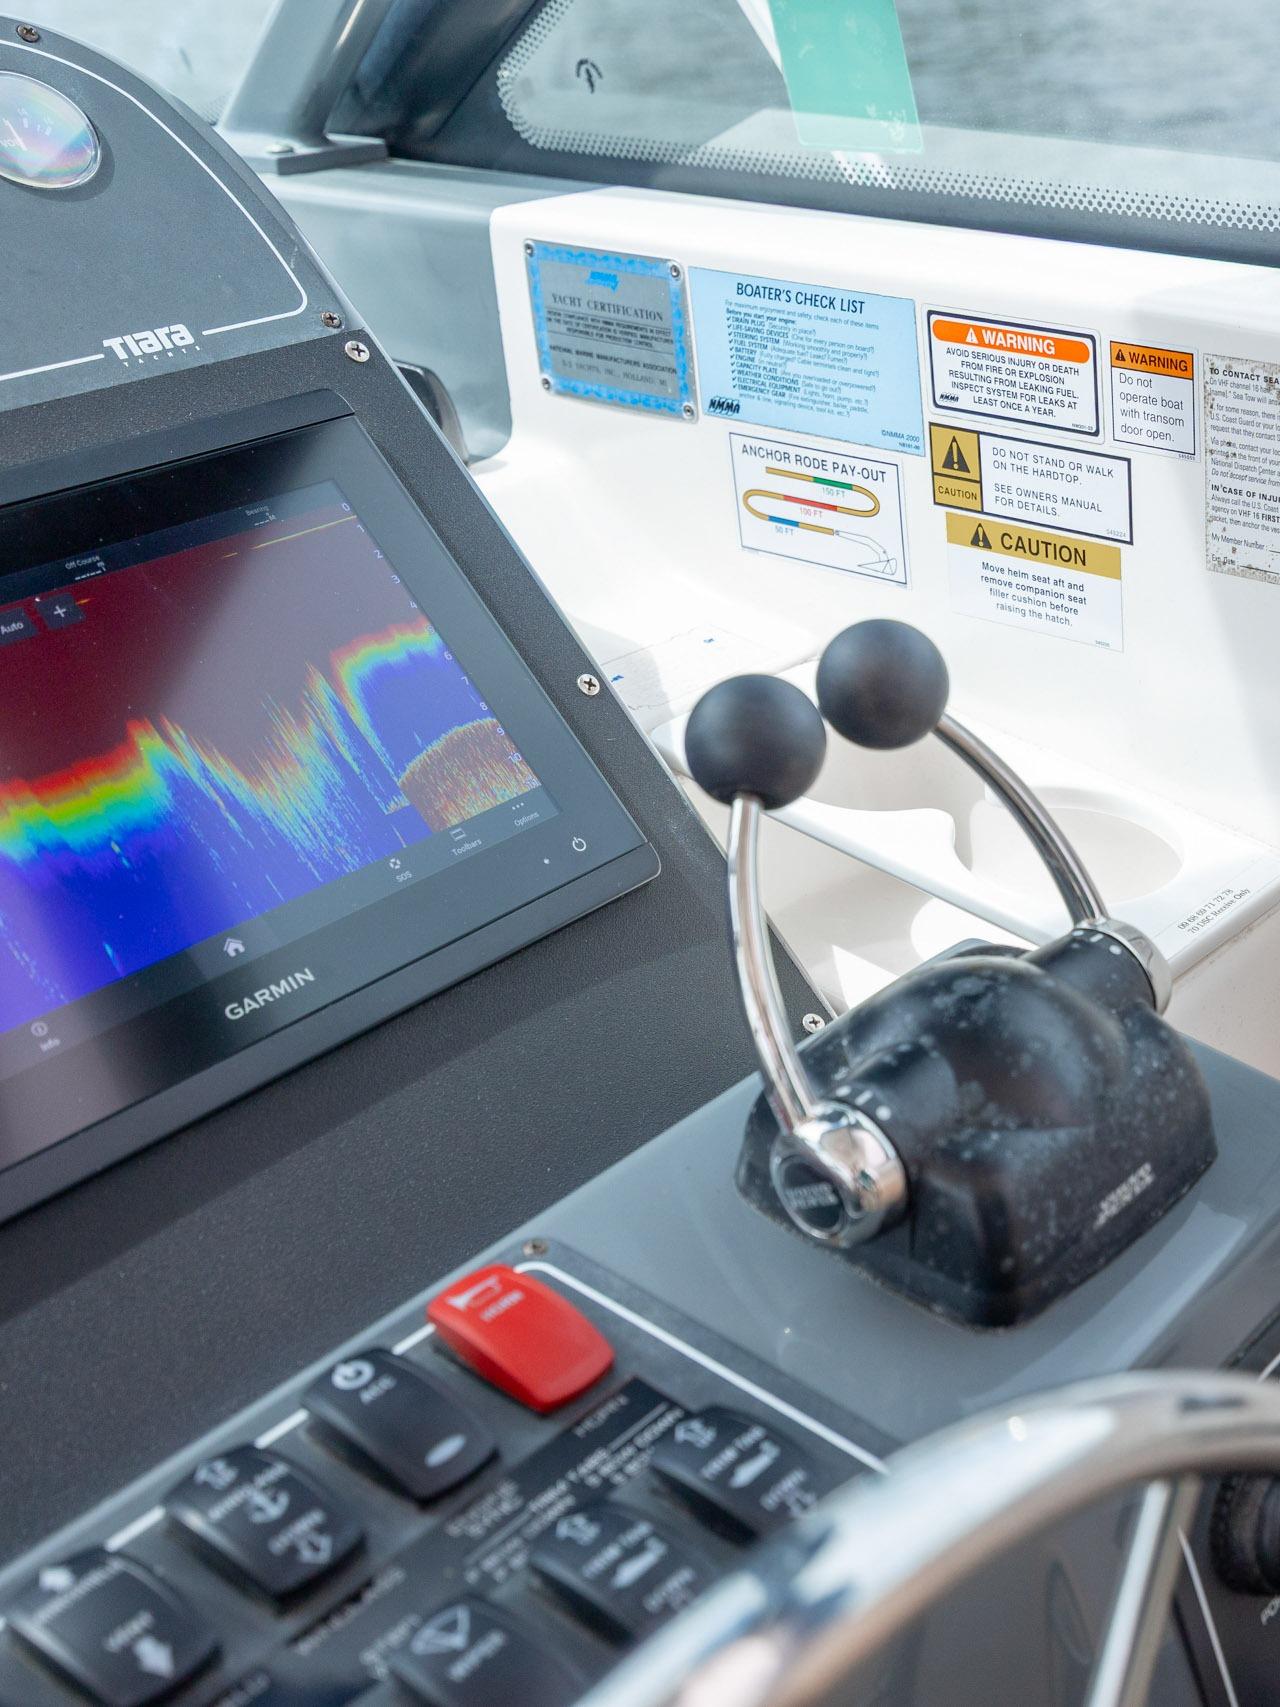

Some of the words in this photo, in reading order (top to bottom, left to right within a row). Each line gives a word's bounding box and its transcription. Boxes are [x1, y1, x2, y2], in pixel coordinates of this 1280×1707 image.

[551, 293, 582, 308] YACHT
[586, 299, 664, 322] CERTIFICATION
[736, 282, 792, 304] BOATER'S
[795, 291, 837, 311] CHECK
[840, 297, 866, 315] LIST
[103, 323, 195, 360] Tiara
[981, 329, 1056, 355] WARNING
[946, 347, 970, 358] AVOID
[971, 350, 1007, 365] SERIOUS
[1007, 357, 1037, 369] INJURY
[1037, 361, 1051, 372] OR
[1052, 364, 1080, 377] DEATH
[960, 360, 984, 372] FROM
[985, 364, 1003, 375] FIRE
[1004, 367, 1017, 378] OR
[1018, 369, 1065, 385] EXPLOSION
[1128, 351, 1188, 373] WARNING
[948, 369, 992, 384] RESULTING
[993, 376, 1017, 389] FROM
[1018, 381, 1054, 395] LEAKING
[1056, 387, 1080, 399] FUEL.
[1119, 372, 1134, 386] Do
[1136, 377, 1153, 389] not
[1208, 366, 1220, 376] TO
[1222, 369, 1261, 382] CONTACT
[1263, 375, 1280, 385] SEA
[951, 381, 984, 394] INSPECT
[985, 386, 1018, 400] SYSTEM
[1019, 392, 1037, 403] FOR
[1038, 395, 1066, 408] LEAKS
[1067, 400, 1078, 410] AT
[972, 395, 999, 408] LEAST
[999, 399, 1023, 412] ONCE
[1024, 404, 1031, 413] A
[1031, 405, 1056, 418] YEAR.
[1119, 391, 1158, 407] operate
[1160, 395, 1184, 411] boat
[1120, 408, 1140, 419] with
[1142, 410, 1185, 428] transom
[1120, 423, 1144, 436] door
[1145, 429, 1175, 443] open.
[741, 443, 791, 464] ANCHOR
[794, 453, 829, 472] RODE
[832, 461, 887, 483] PAY-OUT
[992, 446, 1007, 458] DO
[1009, 450, 1030, 462] NOT
[1032, 454, 1066, 469] STAND
[1068, 461, 1083, 472] OR
[1085, 464, 1114, 479] WALK
[992, 459, 1007, 471] ON
[1009, 462, 1029, 475] THE
[1032, 467, 1082, 486] HARDTOP.
[822, 486, 835, 497] 150
[835, 489, 846, 498] FT
[937, 485, 978, 501] CAUTION
[994, 482, 1013, 495] SEE
[1015, 487, 1058, 504] OWNERS
[1061, 496, 1103, 513] MANUAL
[1211, 483, 1220, 492] IN
[1220, 484, 1244, 497] CASE
[1245, 490, 1257, 499] OF
[799, 506, 812, 517] 100
[812, 509, 823, 519] FT
[994, 495, 1014, 508] FOR
[1017, 500, 1061, 517] DETAILS.
[774, 524, 784, 535] 50
[784, 527, 794, 536] FT
[374, 549, 384, 559] 2
[1000, 532, 1086, 567] CAUTION
[391, 574, 401, 584] 3
[981, 561, 1005, 575] Move
[1007, 567, 1029, 580] helm
[1031, 574, 1051, 585] seat
[1053, 578, 1065, 588] aft
[1067, 582, 1085, 593] and
[980, 575, 1014, 589] remove
[1015, 583, 1065, 600] companion
[1067, 594, 1087, 606] seat
[989, 587, 1010, 599] filler
[1011, 594, 1047, 608] cushion
[1049, 600, 1079, 616] before
[996, 602, 1027, 618] raising
[1028, 608, 1043, 620] the
[1045, 611, 1073, 627] hatch.
[0, 621, 24, 635] Auto
[443, 651, 453, 661] 6
[460, 676, 470, 685] 7
[479, 702, 488, 711] 8
[496, 727, 505, 737] 9
[513, 810, 540, 828] Options
[451, 837, 482, 858] Toolbars
[396, 870, 412, 883] SOS
[225, 967, 315, 1020] GARMIN
